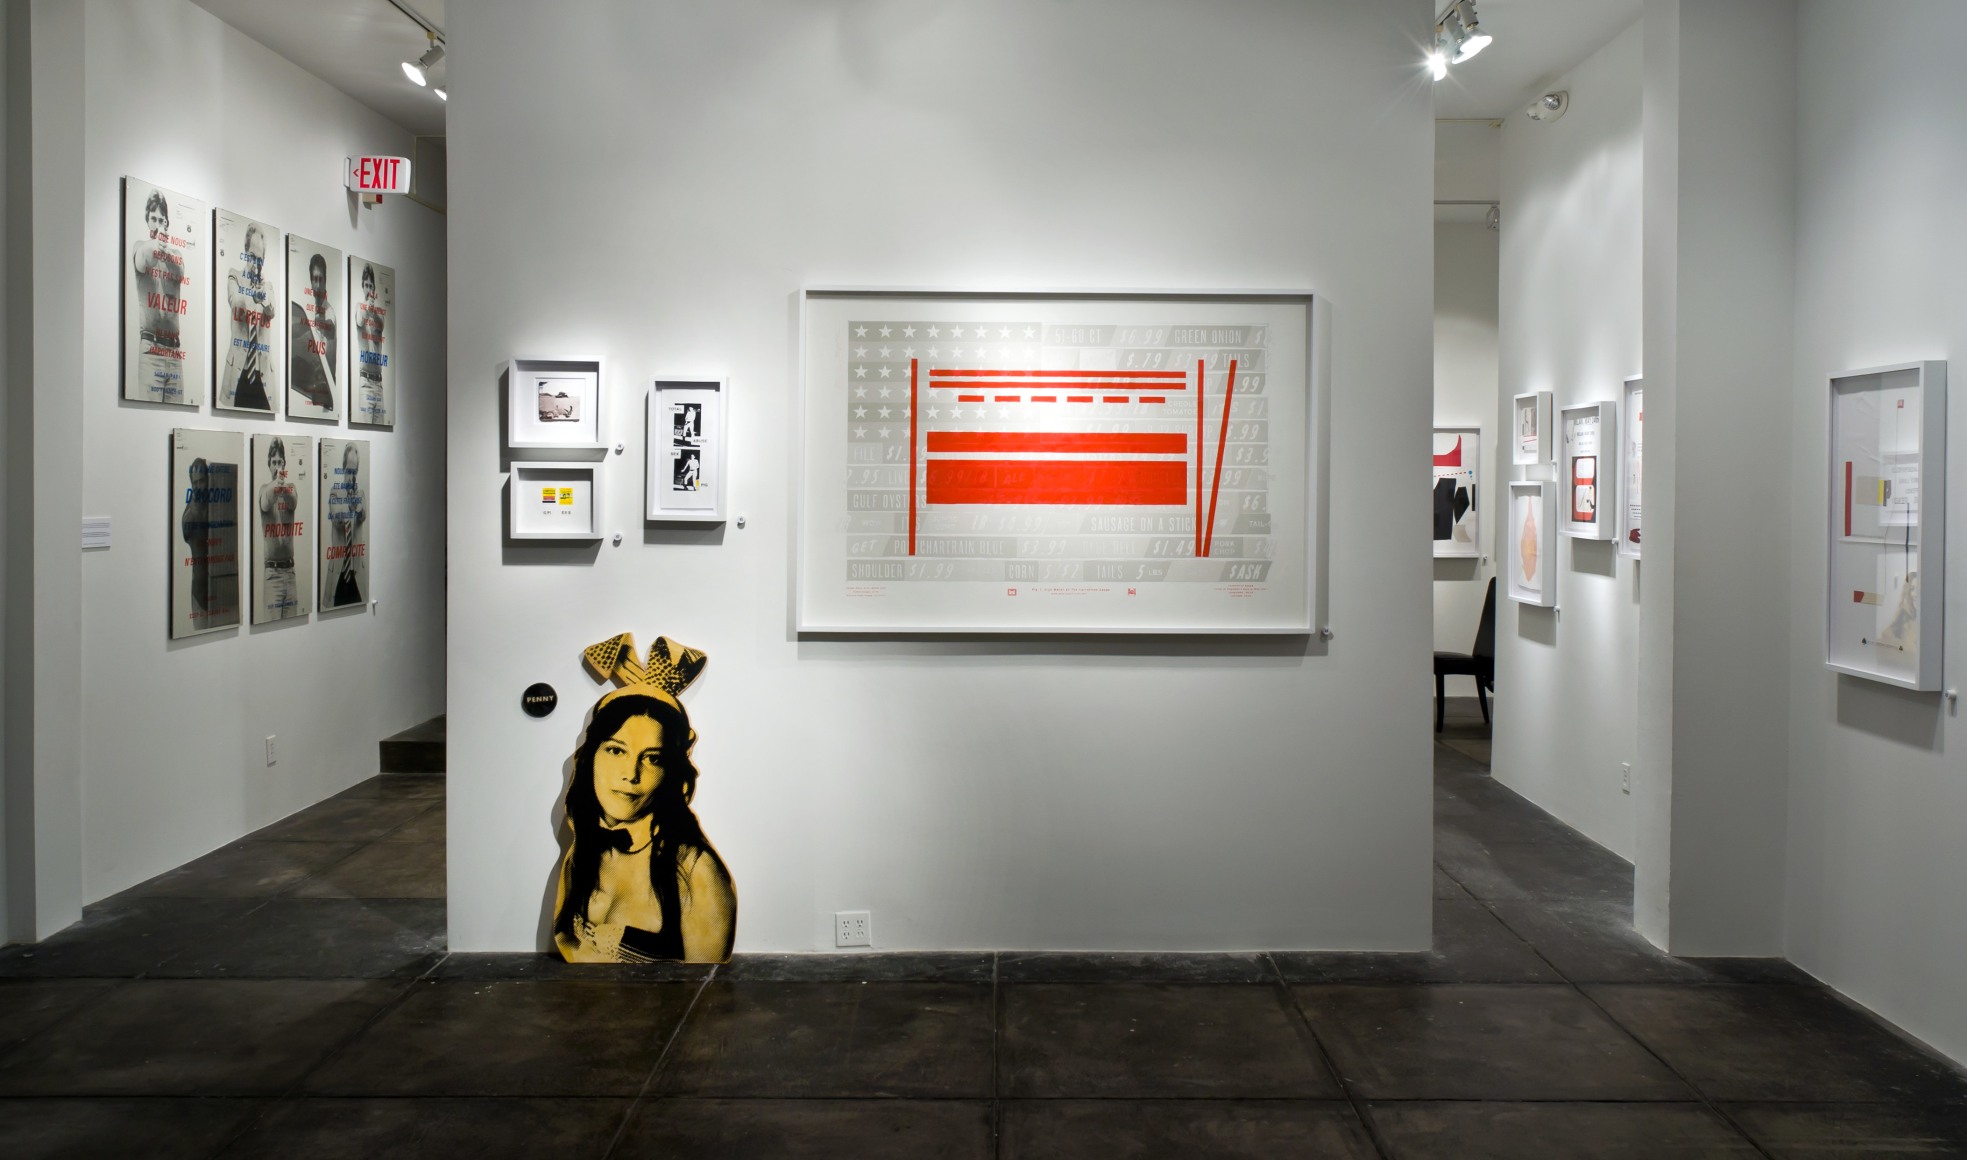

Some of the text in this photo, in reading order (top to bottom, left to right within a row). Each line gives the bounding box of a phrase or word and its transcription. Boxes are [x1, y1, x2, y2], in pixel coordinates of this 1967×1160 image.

[359, 157, 401, 190] EXIT
[171, 235, 187, 248] NOUS
[147, 291, 188, 316] VALEUR
[245, 309, 271, 329] REFUS
[1055, 328, 1102, 344] 51-60 CT
[1174, 329, 1242, 344] GREEN ONION
[307, 338, 327, 356] PLUS
[359, 350, 389, 367] HORREUR
[1126, 352, 1162, 369] $.79
[1163, 408, 1201, 416] TOMATOE
[886, 446, 926, 461] $1.9
[185, 487, 234, 504] D'ACCORD
[853, 494, 926, 509] GULF OYSTRS
[264, 522, 304, 538] PRODUITE
[1091, 517, 1196, 532] SAUSAGE ON A STICK
[851, 539, 879, 554] GET
[894, 540, 974, 555] POCHARTRAIN
[979, 540, 1004, 555] BLUE
[1022, 540, 1067, 556] $3.99
[1153, 540, 1195, 556] $1.49
[851, 563, 955, 579] SHOULDER $1.99
[1009, 564, 1035, 579] CORN
[1096, 564, 1124, 579] TAILS
[1229, 564, 1263, 580] $ASK
[526, 695, 554, 703] PENNY
